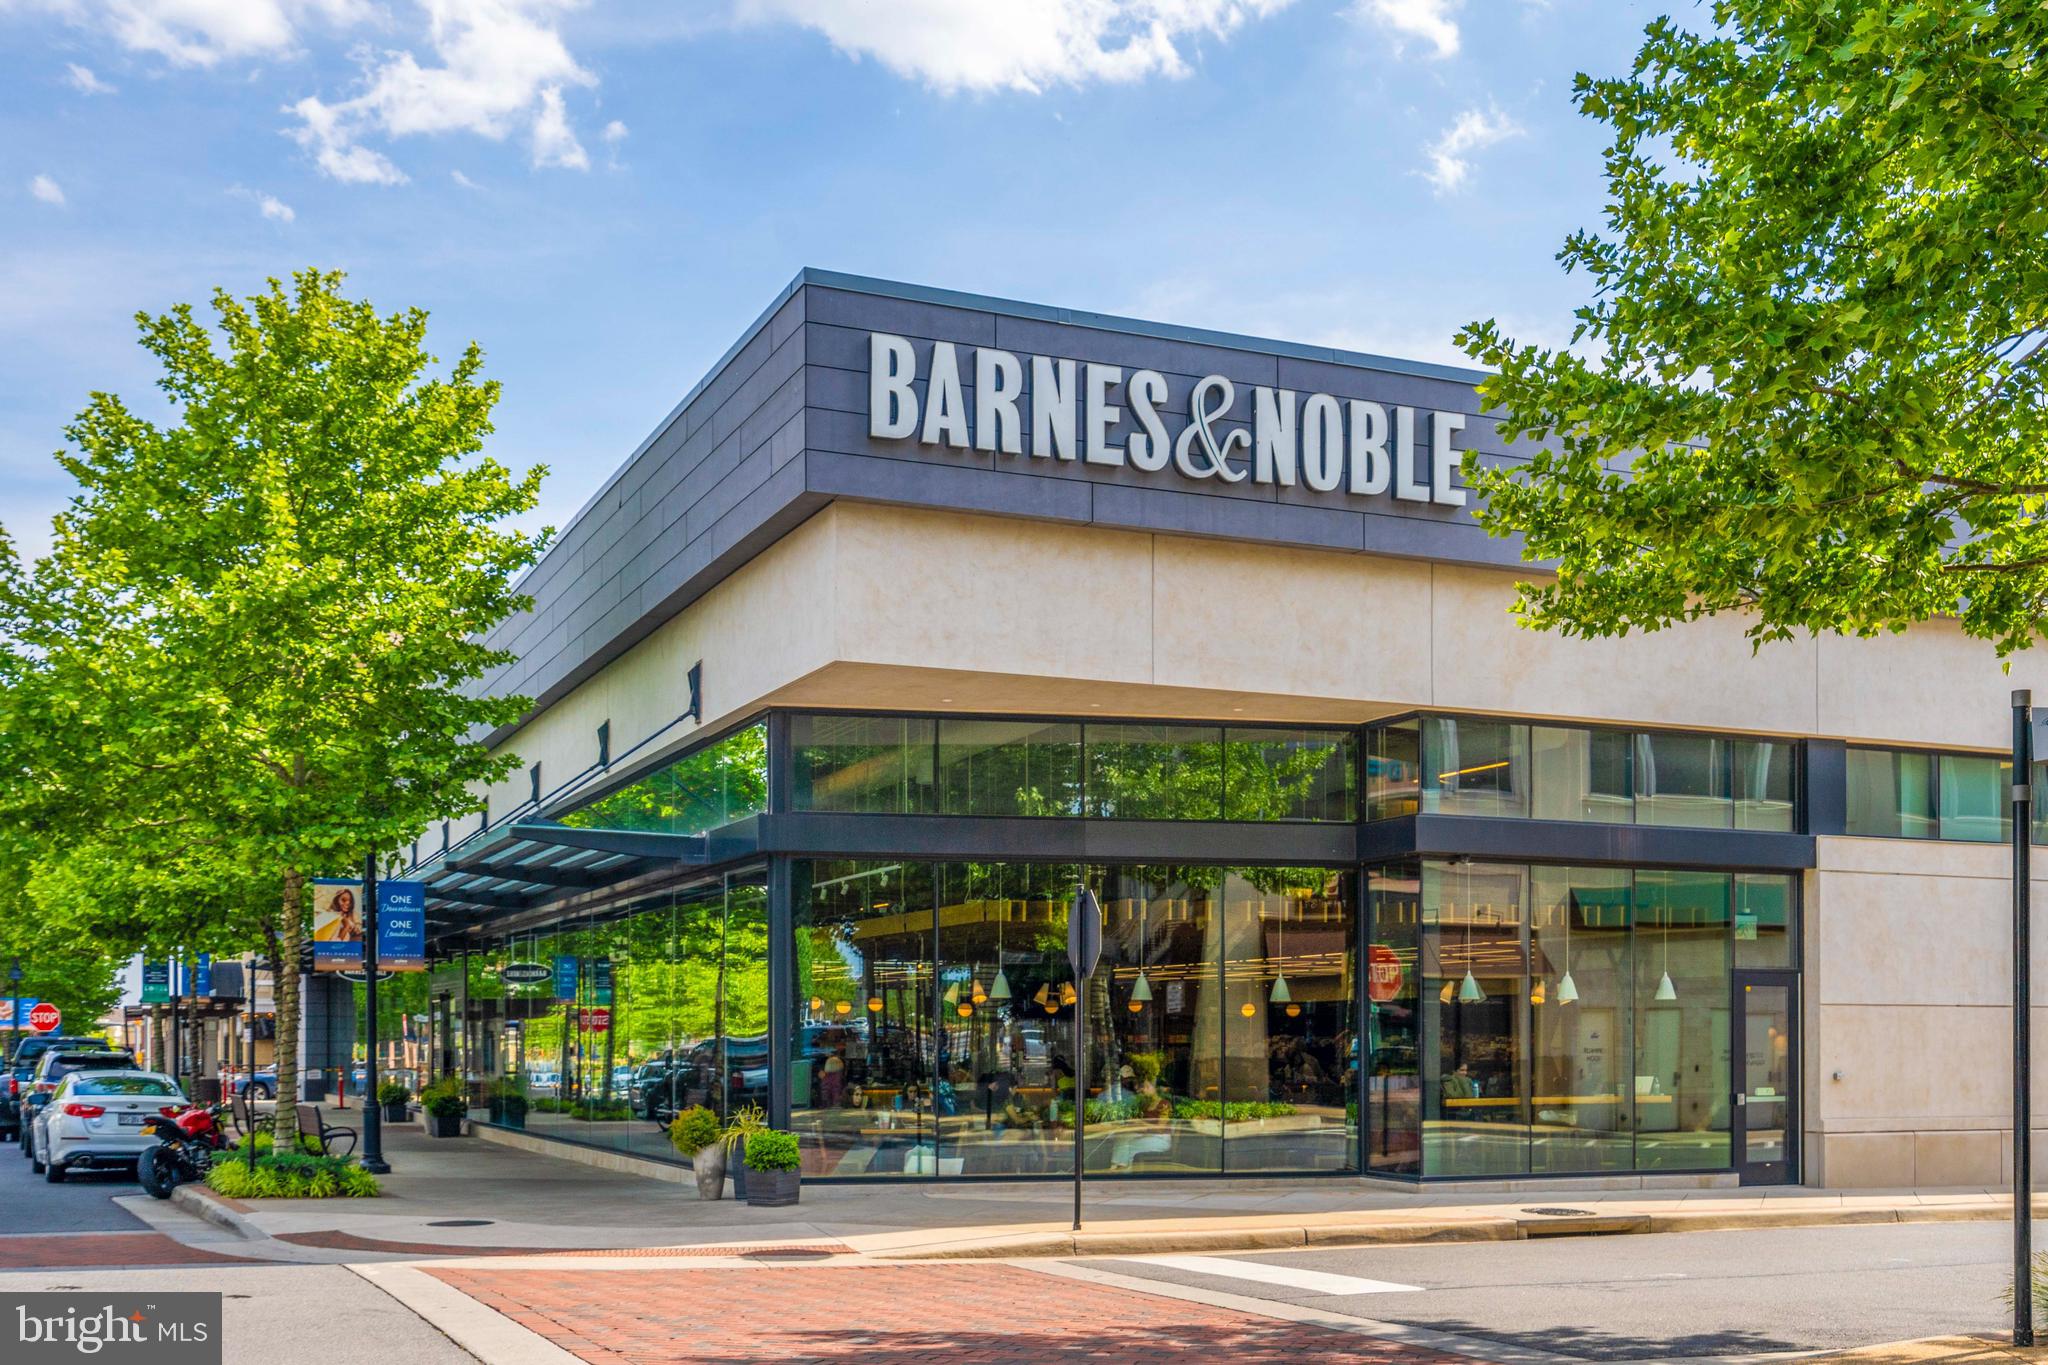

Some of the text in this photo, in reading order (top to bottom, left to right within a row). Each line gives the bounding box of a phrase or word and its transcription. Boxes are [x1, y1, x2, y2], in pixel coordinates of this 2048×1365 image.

[868, 331, 1468, 507] BARNES & NOBLE
[390, 895, 412, 904] ONE
[390, 920, 412, 929] ONE
[1370, 963, 1399, 983] TOP
[31, 1012, 58, 1024] STOP
